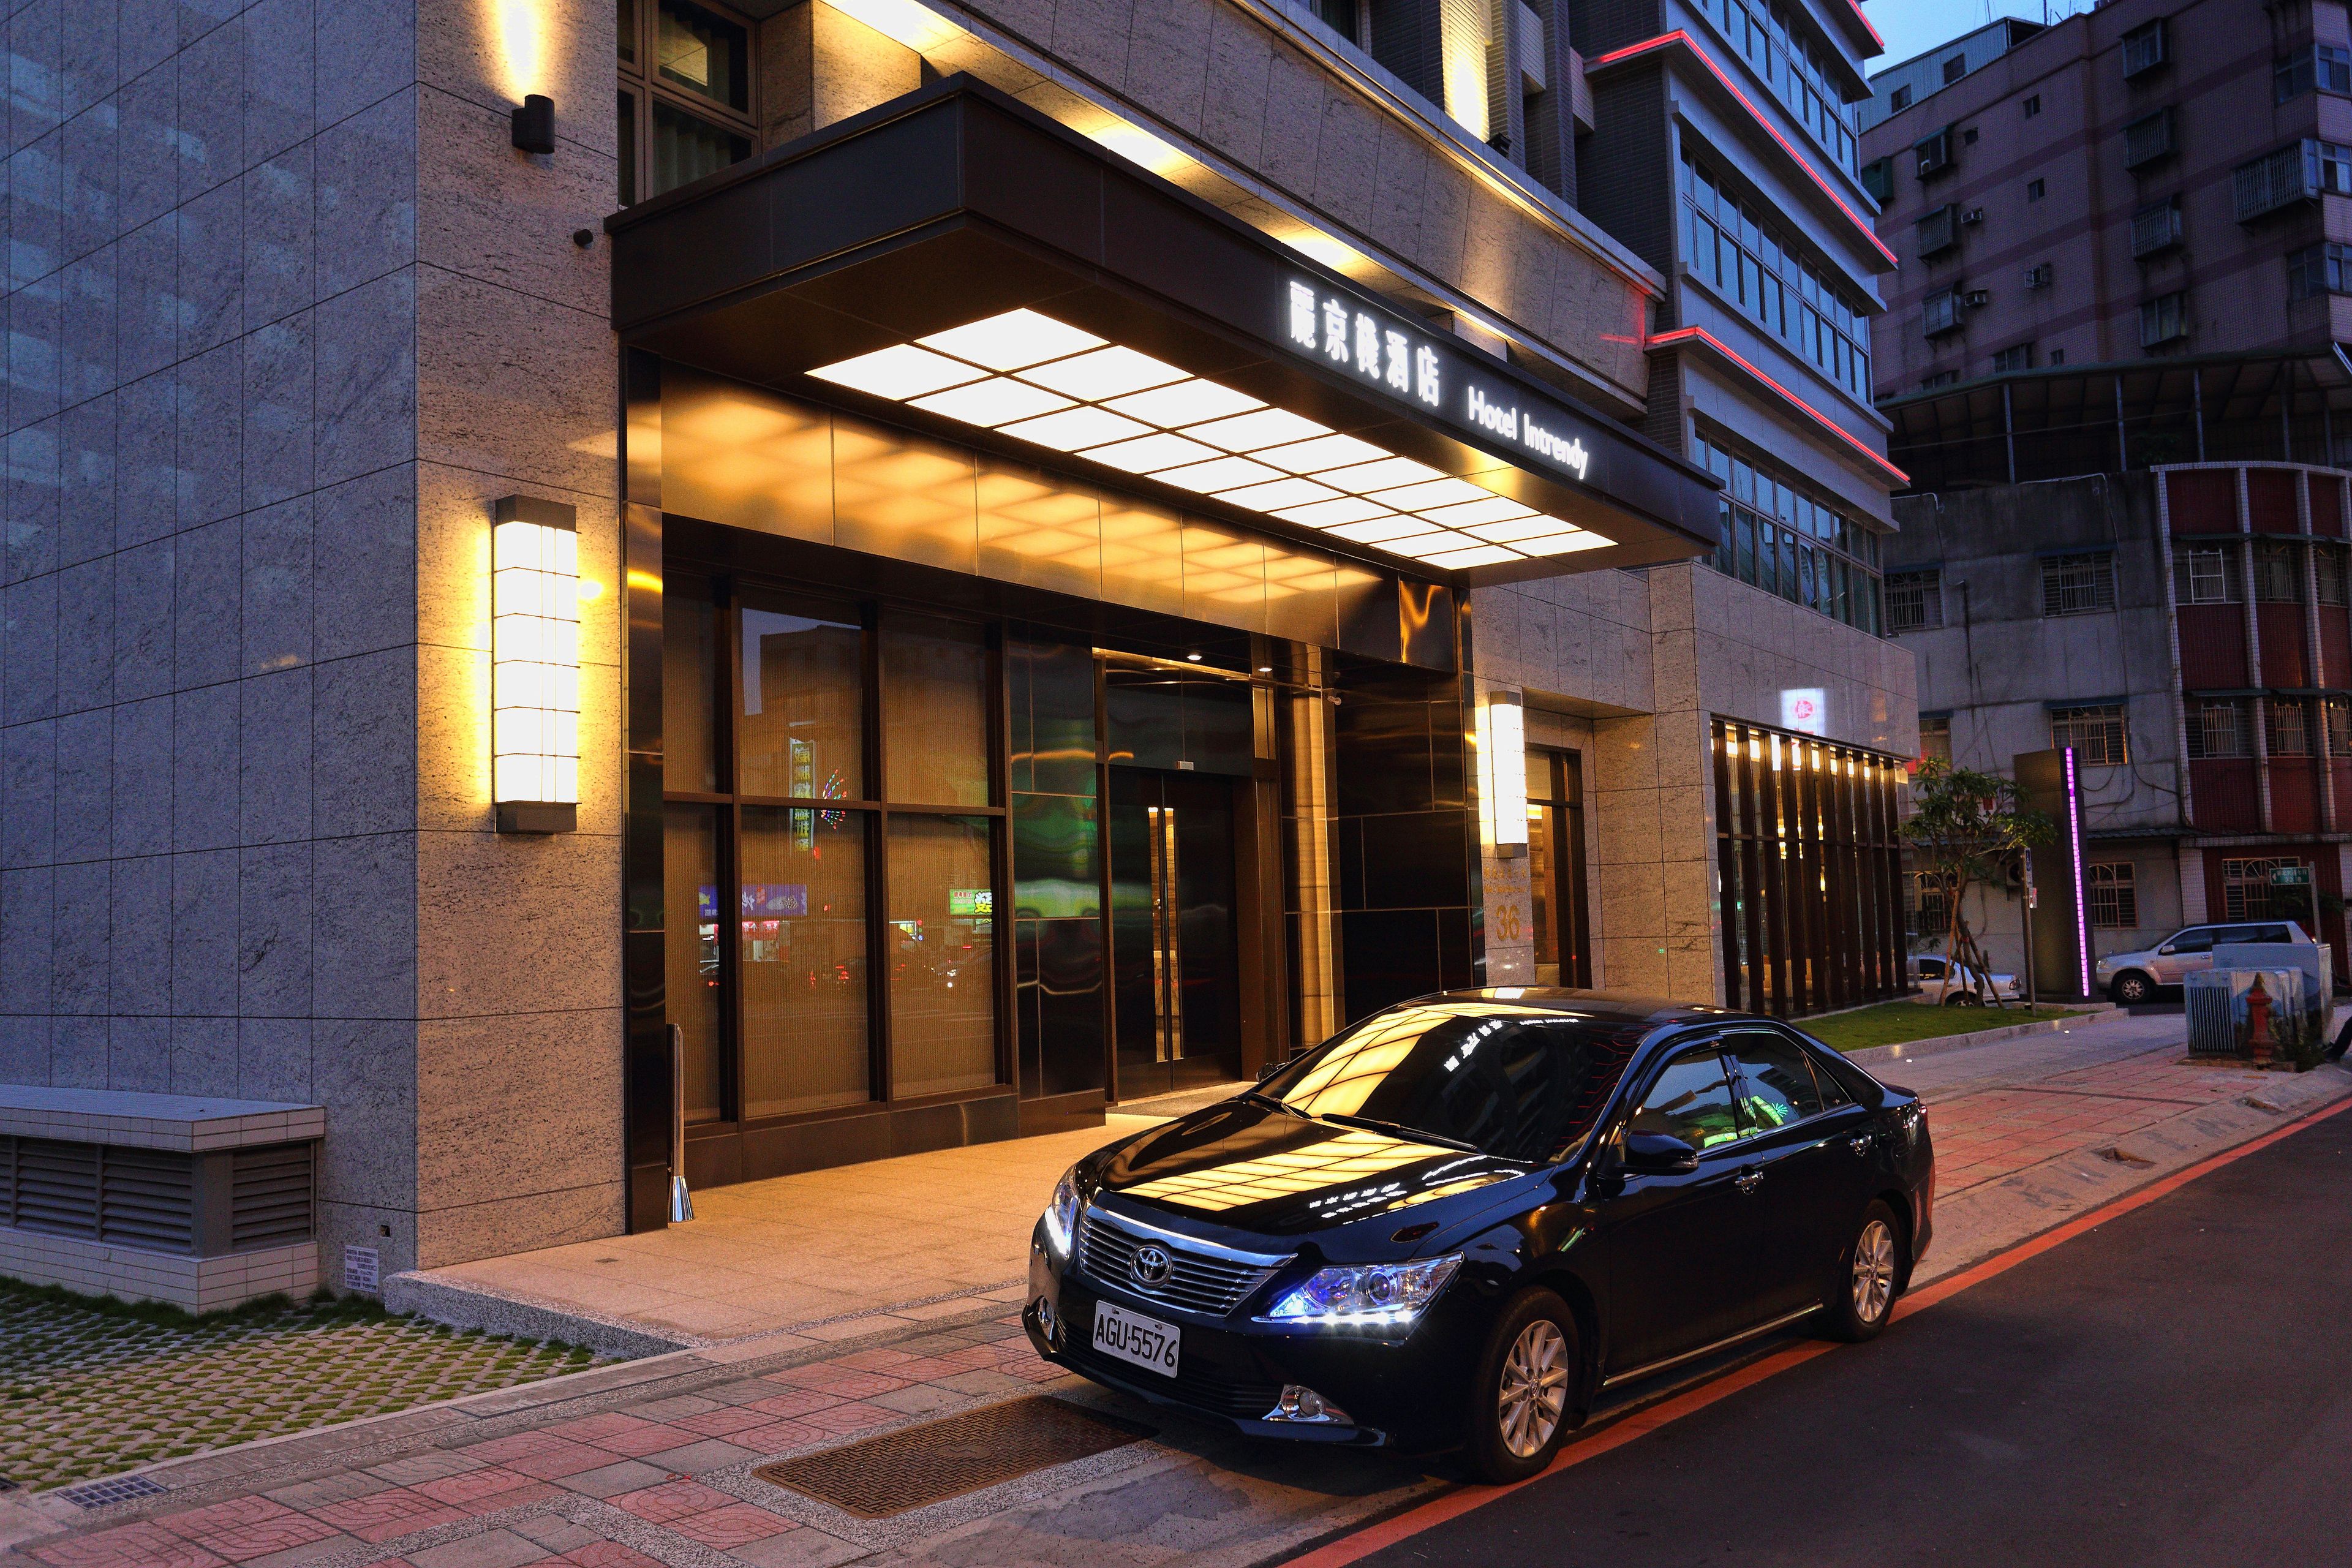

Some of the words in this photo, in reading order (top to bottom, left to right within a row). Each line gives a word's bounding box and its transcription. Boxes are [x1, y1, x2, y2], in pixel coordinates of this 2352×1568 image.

[1468, 386, 1517, 440] Hotel
[1524, 413, 1588, 480] Intrendy
[1496, 904, 1520, 941] 36
